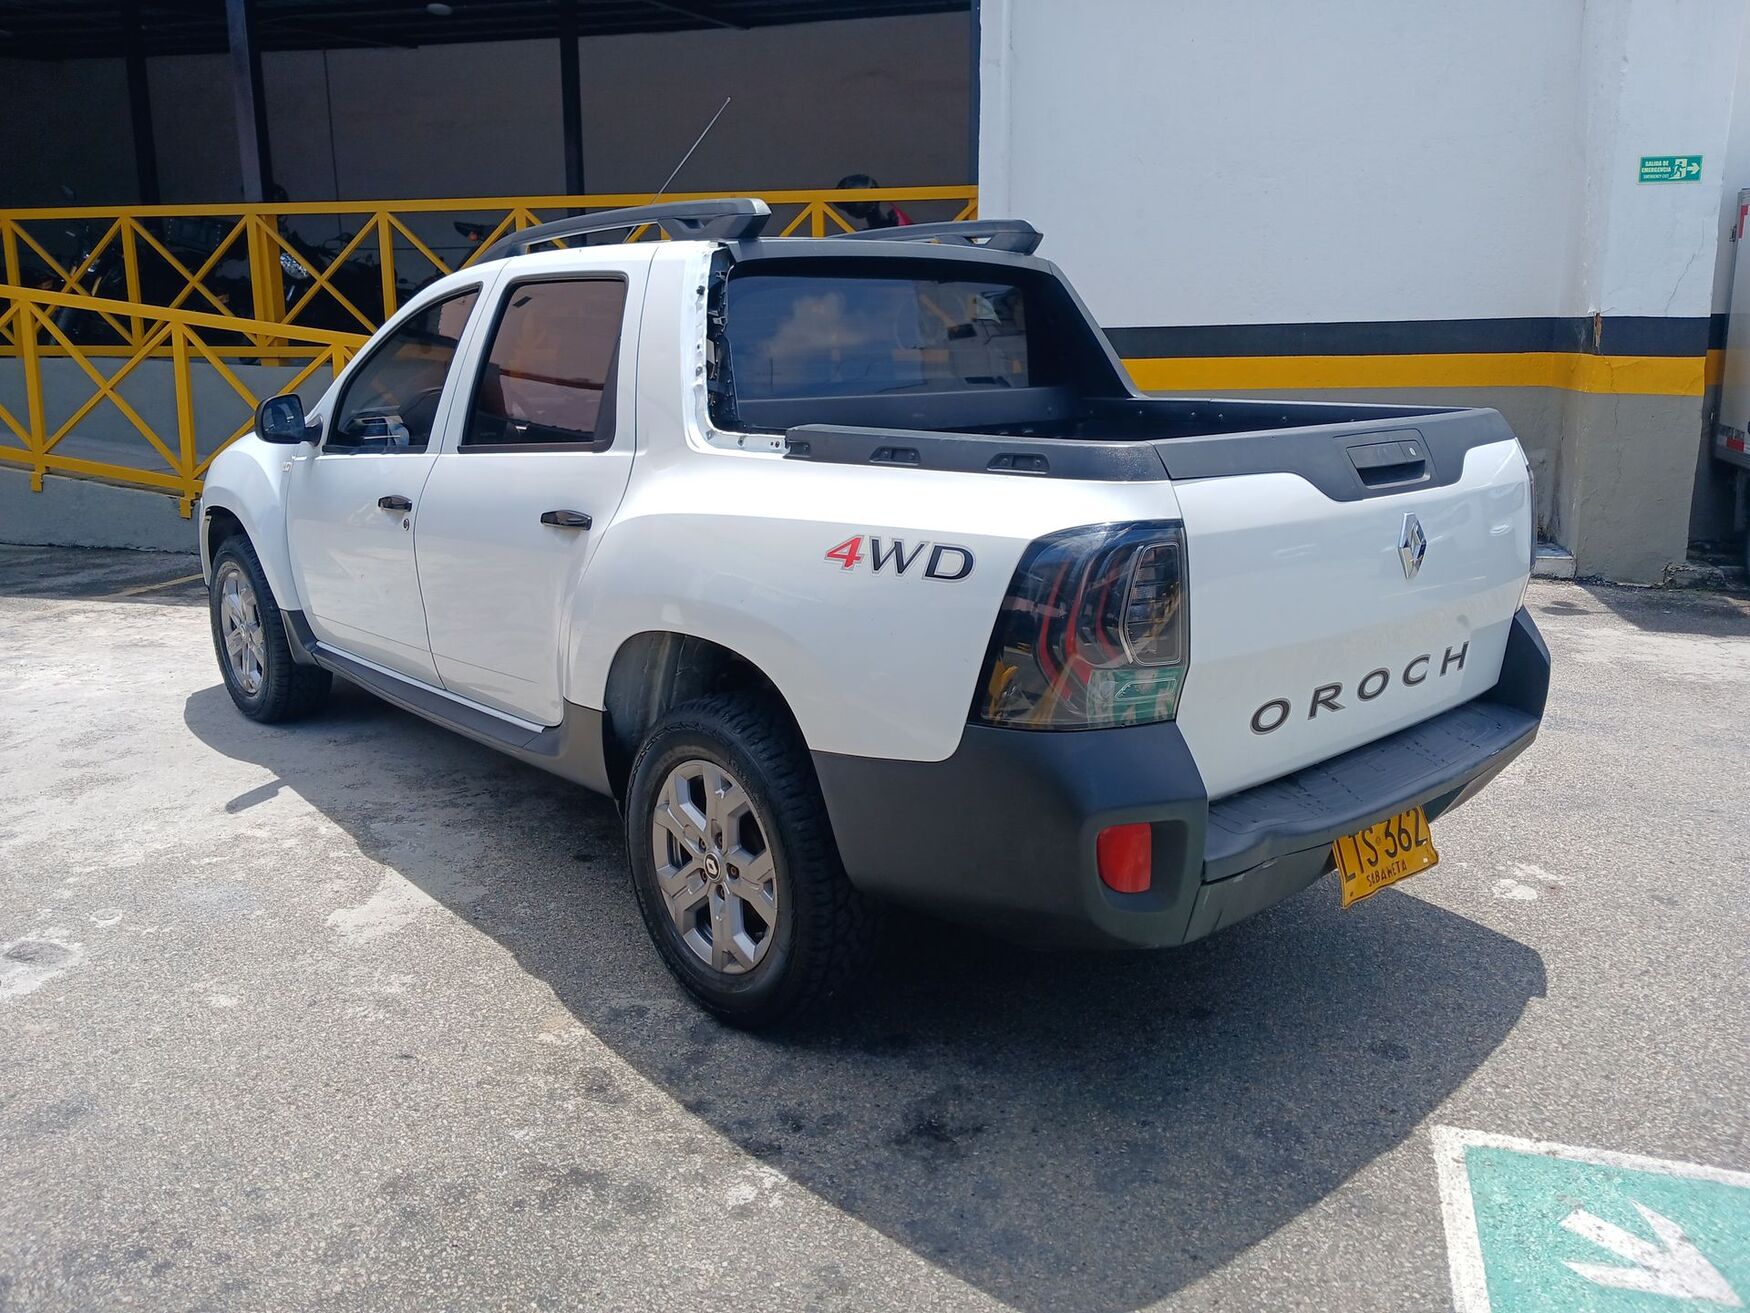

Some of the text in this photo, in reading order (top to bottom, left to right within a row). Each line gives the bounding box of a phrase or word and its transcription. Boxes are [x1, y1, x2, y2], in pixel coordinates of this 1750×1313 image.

[824, 534, 976, 583] 4WD
[1249, 641, 1470, 735] OROCH
[1366, 859, 1408, 887] SABANETA
